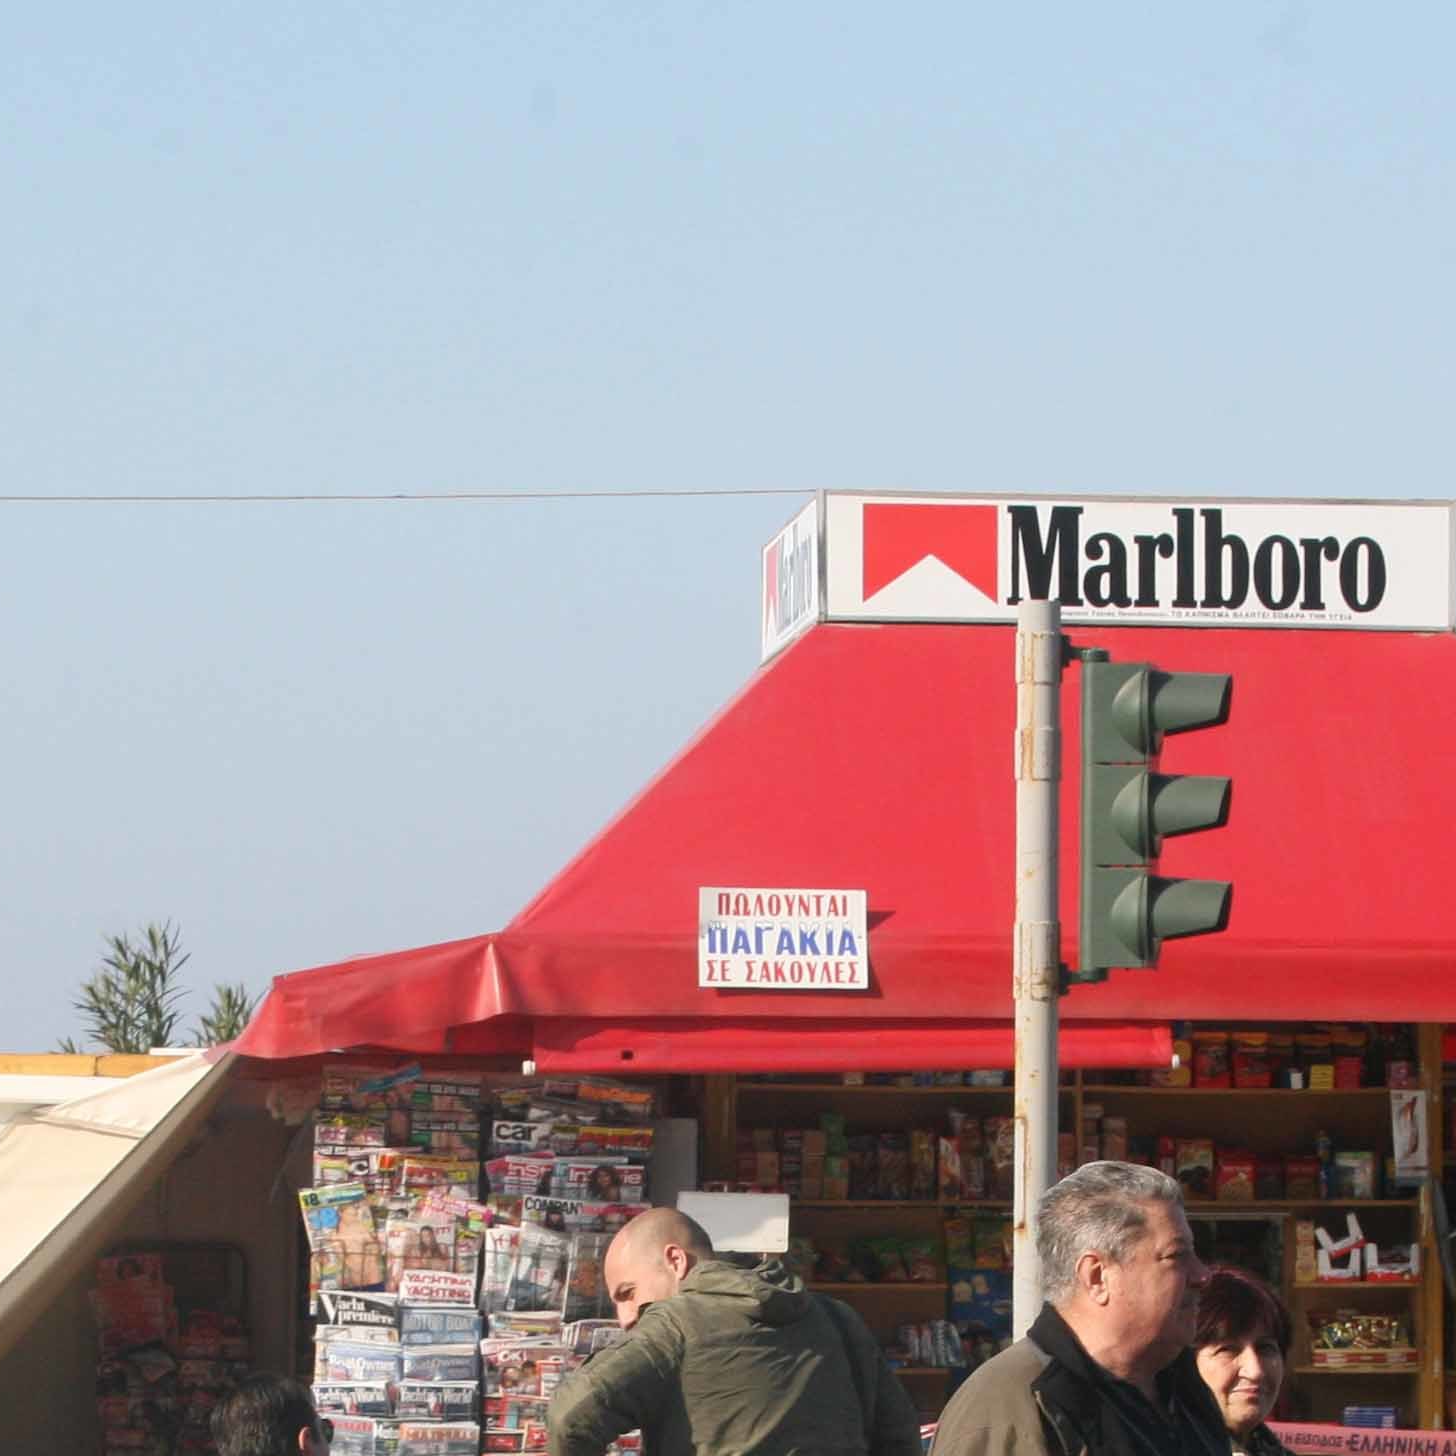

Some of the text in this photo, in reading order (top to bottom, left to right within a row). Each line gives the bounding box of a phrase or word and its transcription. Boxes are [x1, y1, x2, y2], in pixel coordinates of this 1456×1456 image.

[1007, 504, 1386, 613] Marlboro
[717, 892, 848, 917] ΠΩΛΟΥΝΤΑΙ
[706, 922, 859, 956] ΠΑΓΑΚΙΑ
[706, 960, 861, 984] ΣΕ ΣΑΚΟΥΛΕΣ
[1349, 1433, 1438, 1456] ΕΛΛΗΝΙΚΗ
